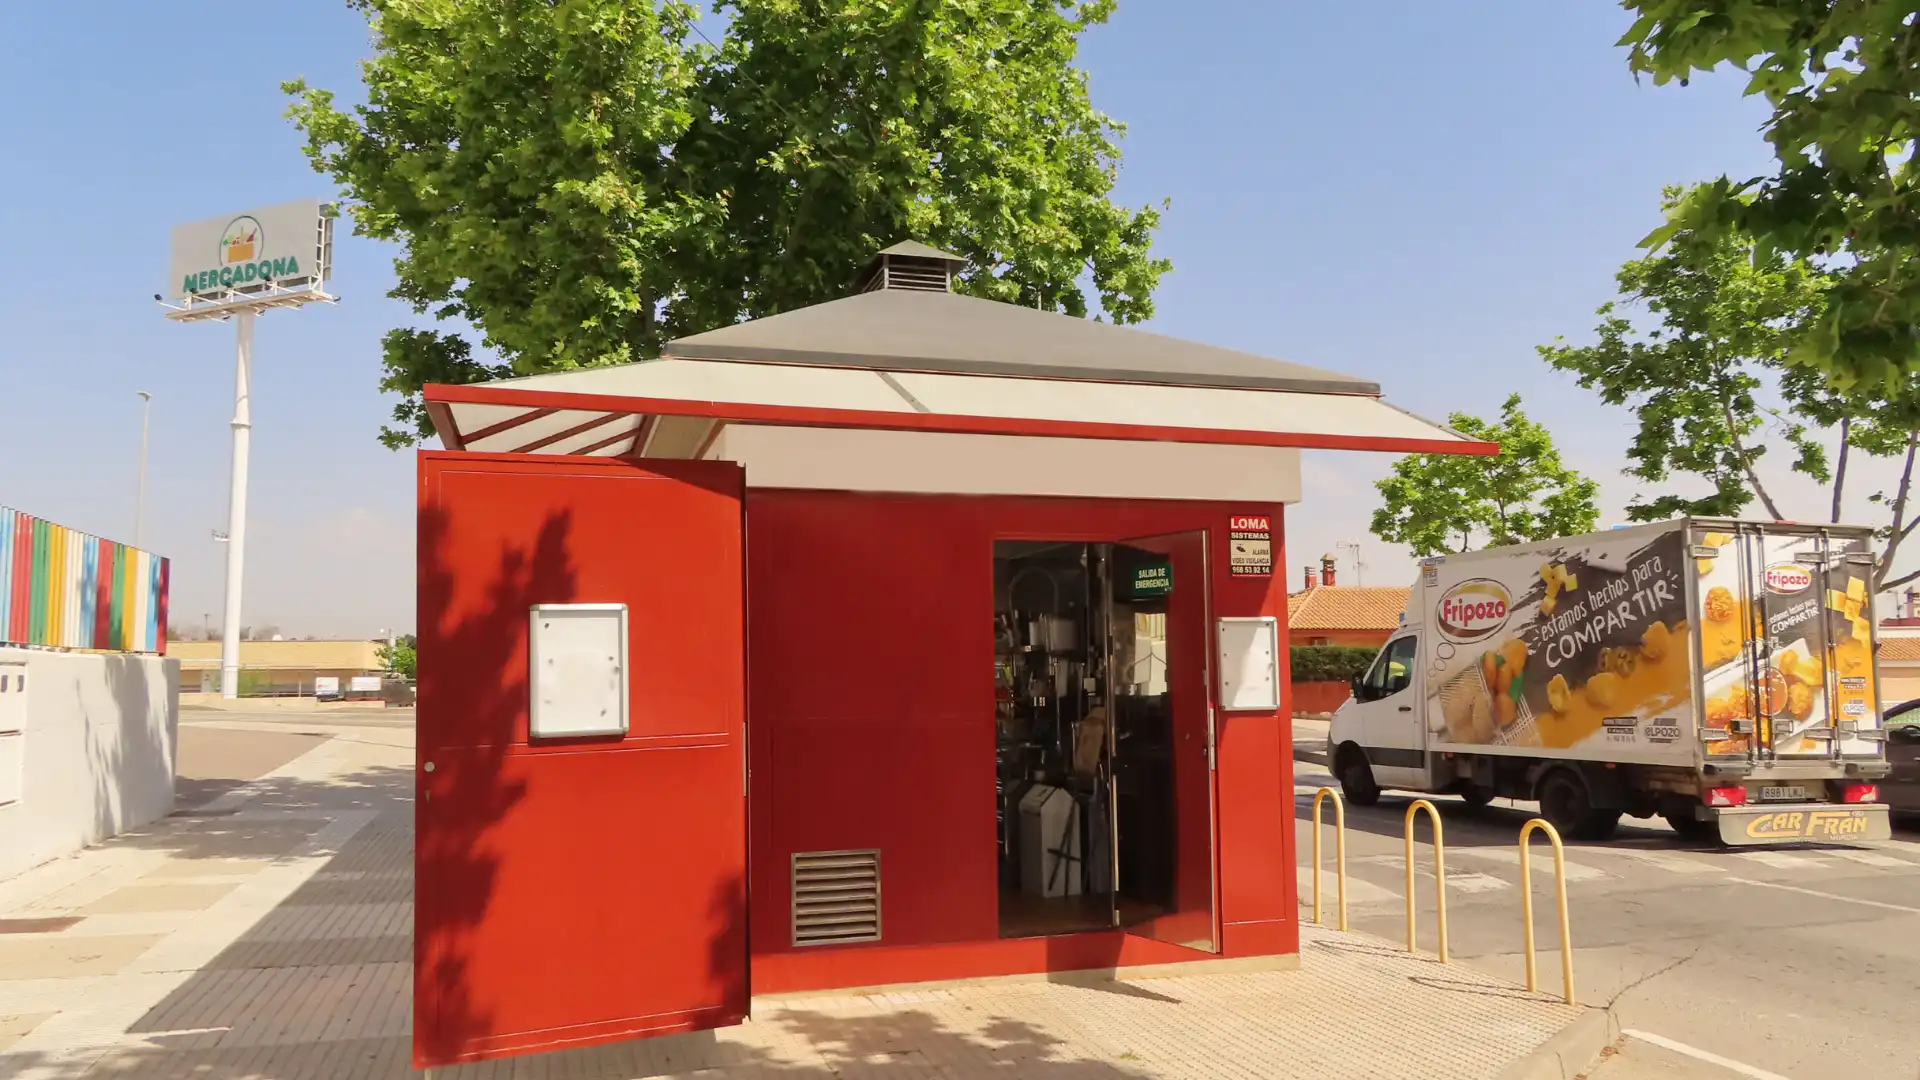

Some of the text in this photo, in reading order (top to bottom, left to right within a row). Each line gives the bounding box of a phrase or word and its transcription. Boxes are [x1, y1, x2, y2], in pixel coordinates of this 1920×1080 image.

[183, 255, 299, 293] MERCADONA
[1231, 517, 1269, 530] LOMA
[1135, 578, 1170, 589] EMERGENCIA
[1138, 567, 1166, 578] SALIDA DE
[1767, 571, 1809, 588] Fripozo
[1540, 556, 1662, 639] estamos hechos para
[1442, 598, 1507, 627] Fripozo
[1545, 579, 1675, 668] COMPARTIR
[1771, 606, 1820, 634] COMPARTIR
[1746, 811, 1804, 838] CAR
[1804, 811, 1868, 836] FRAN
